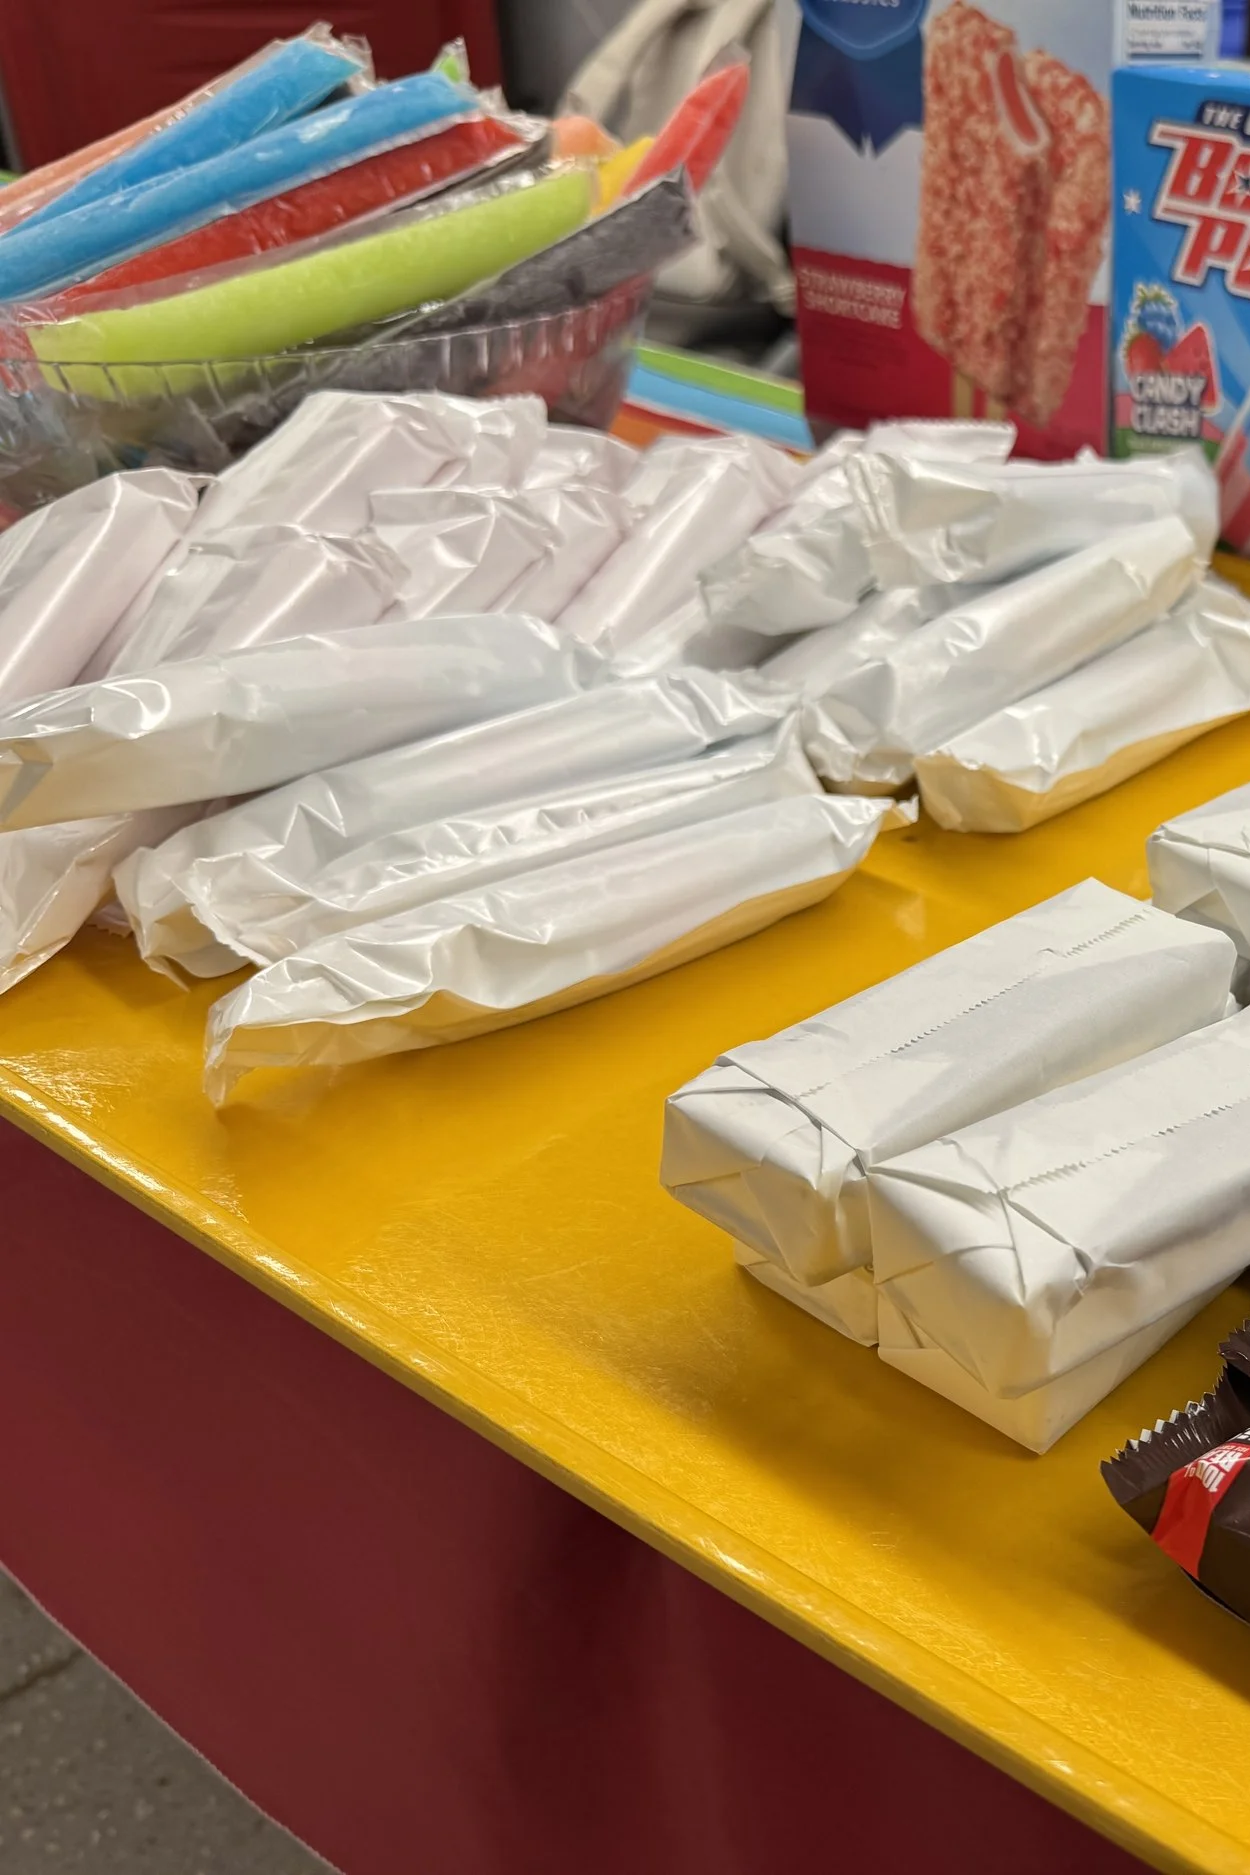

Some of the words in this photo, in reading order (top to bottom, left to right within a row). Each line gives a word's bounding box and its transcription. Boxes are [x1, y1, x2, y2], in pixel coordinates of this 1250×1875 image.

[1203, 104, 1242, 130] THE
[799, 268, 905, 302] STRAWBERRY
[803, 290, 900, 330] SHORTCAKE
[1131, 374, 1206, 406] CANDY
[1131, 404, 1199, 437] CLASH
